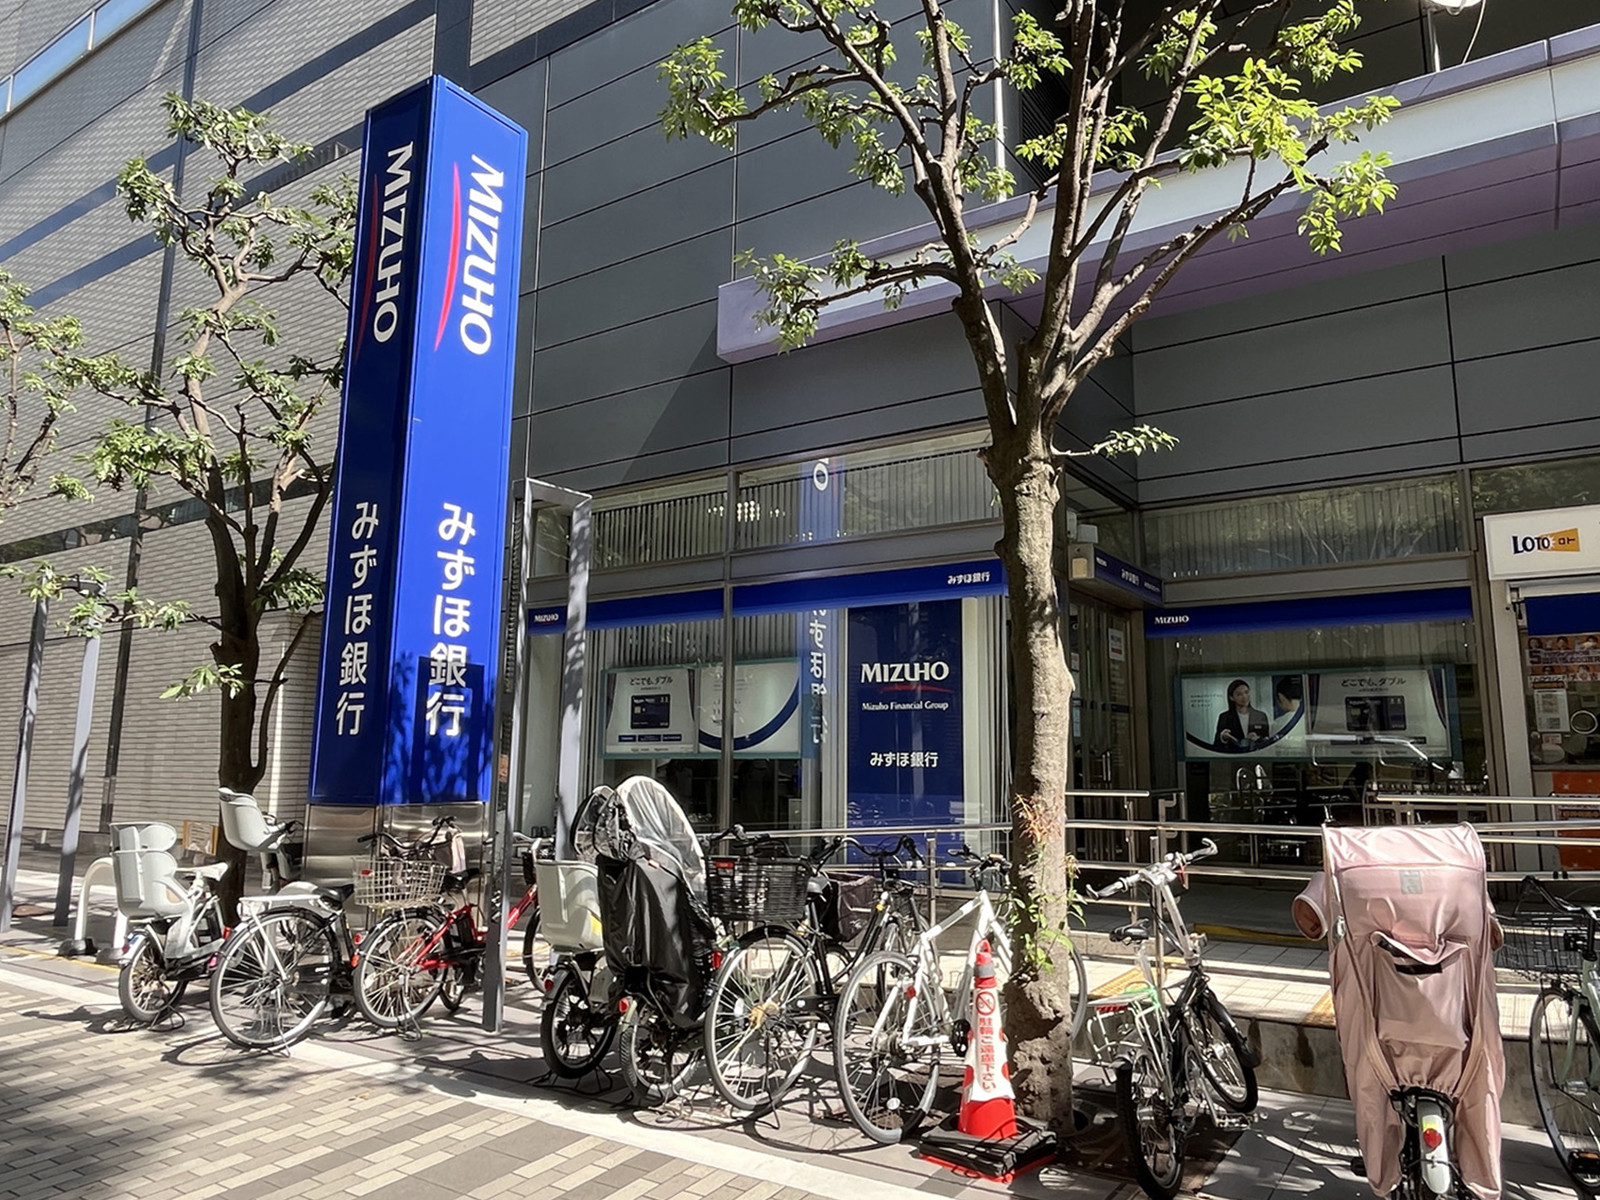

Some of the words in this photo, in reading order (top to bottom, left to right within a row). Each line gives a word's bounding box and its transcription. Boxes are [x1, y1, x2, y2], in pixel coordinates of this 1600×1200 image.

[373, 141, 414, 343] MIZUHO
[460, 154, 504, 356] MIZUHO
[1512, 535, 1551, 555] LOTO
[947, 571, 990, 585] みずほ銀行
[335, 501, 379, 736] みずほ銀行
[425, 502, 476, 737] みずほ銀行
[1154, 615, 1190, 625] MIZUHO
[860, 661, 950, 684] MIZUHO
[861, 701, 889, 711] Mizuho
[890, 700, 923, 711] Financial
[924, 700, 949, 711] Group
[869, 751, 939, 768] みずほ銀行
